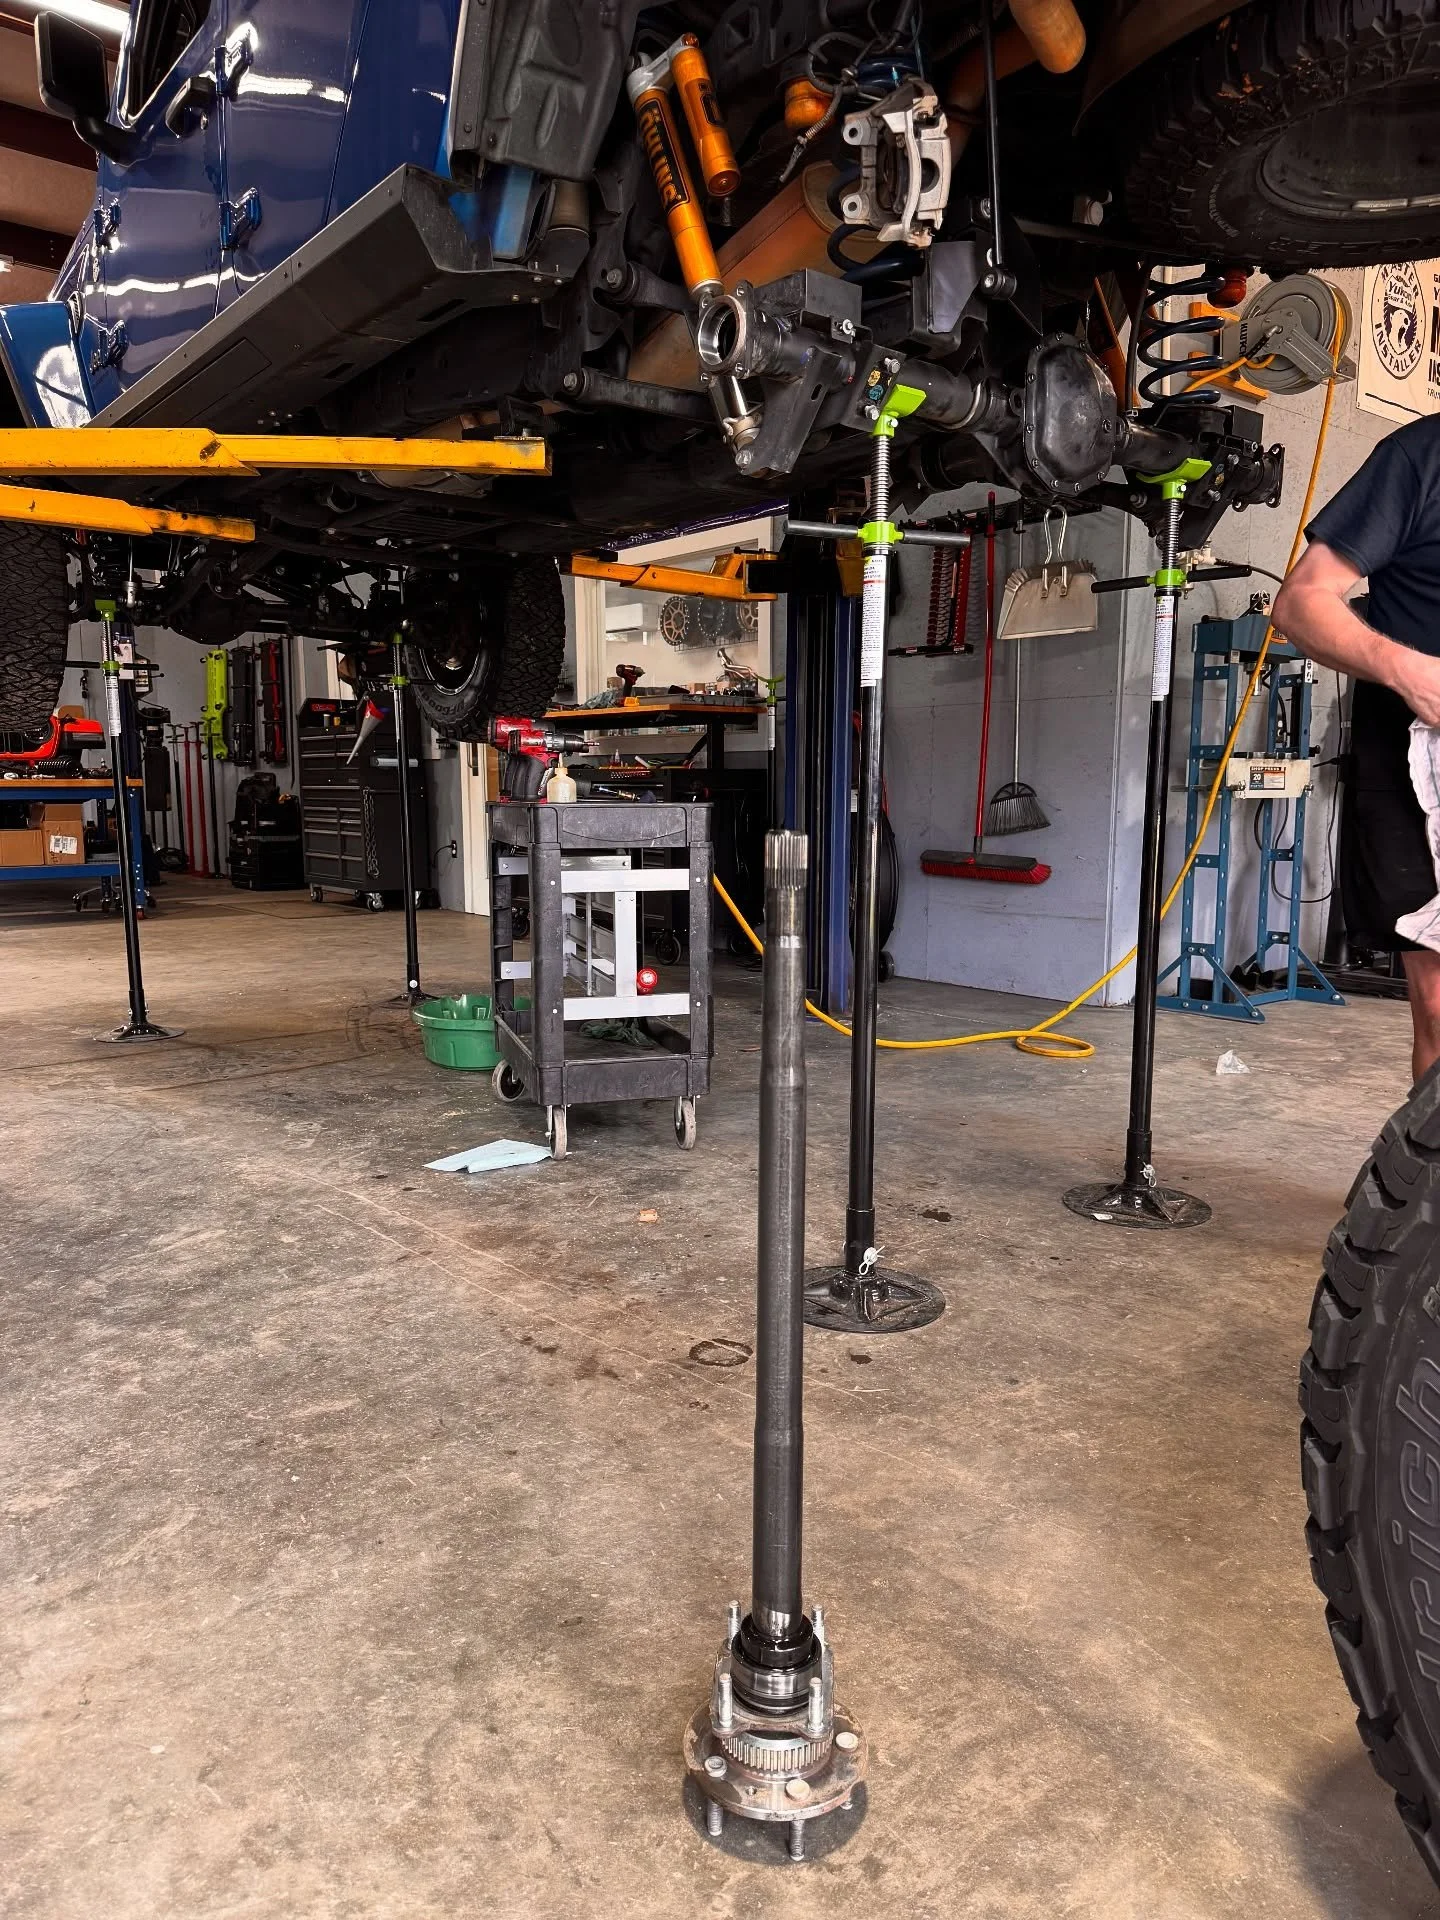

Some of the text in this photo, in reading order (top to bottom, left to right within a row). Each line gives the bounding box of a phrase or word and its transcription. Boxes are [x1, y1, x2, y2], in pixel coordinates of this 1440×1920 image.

[1381, 262, 1419, 299] MASTER
[1375, 323, 1421, 372] INSTALLER
[1253, 773, 1261, 781] 20
